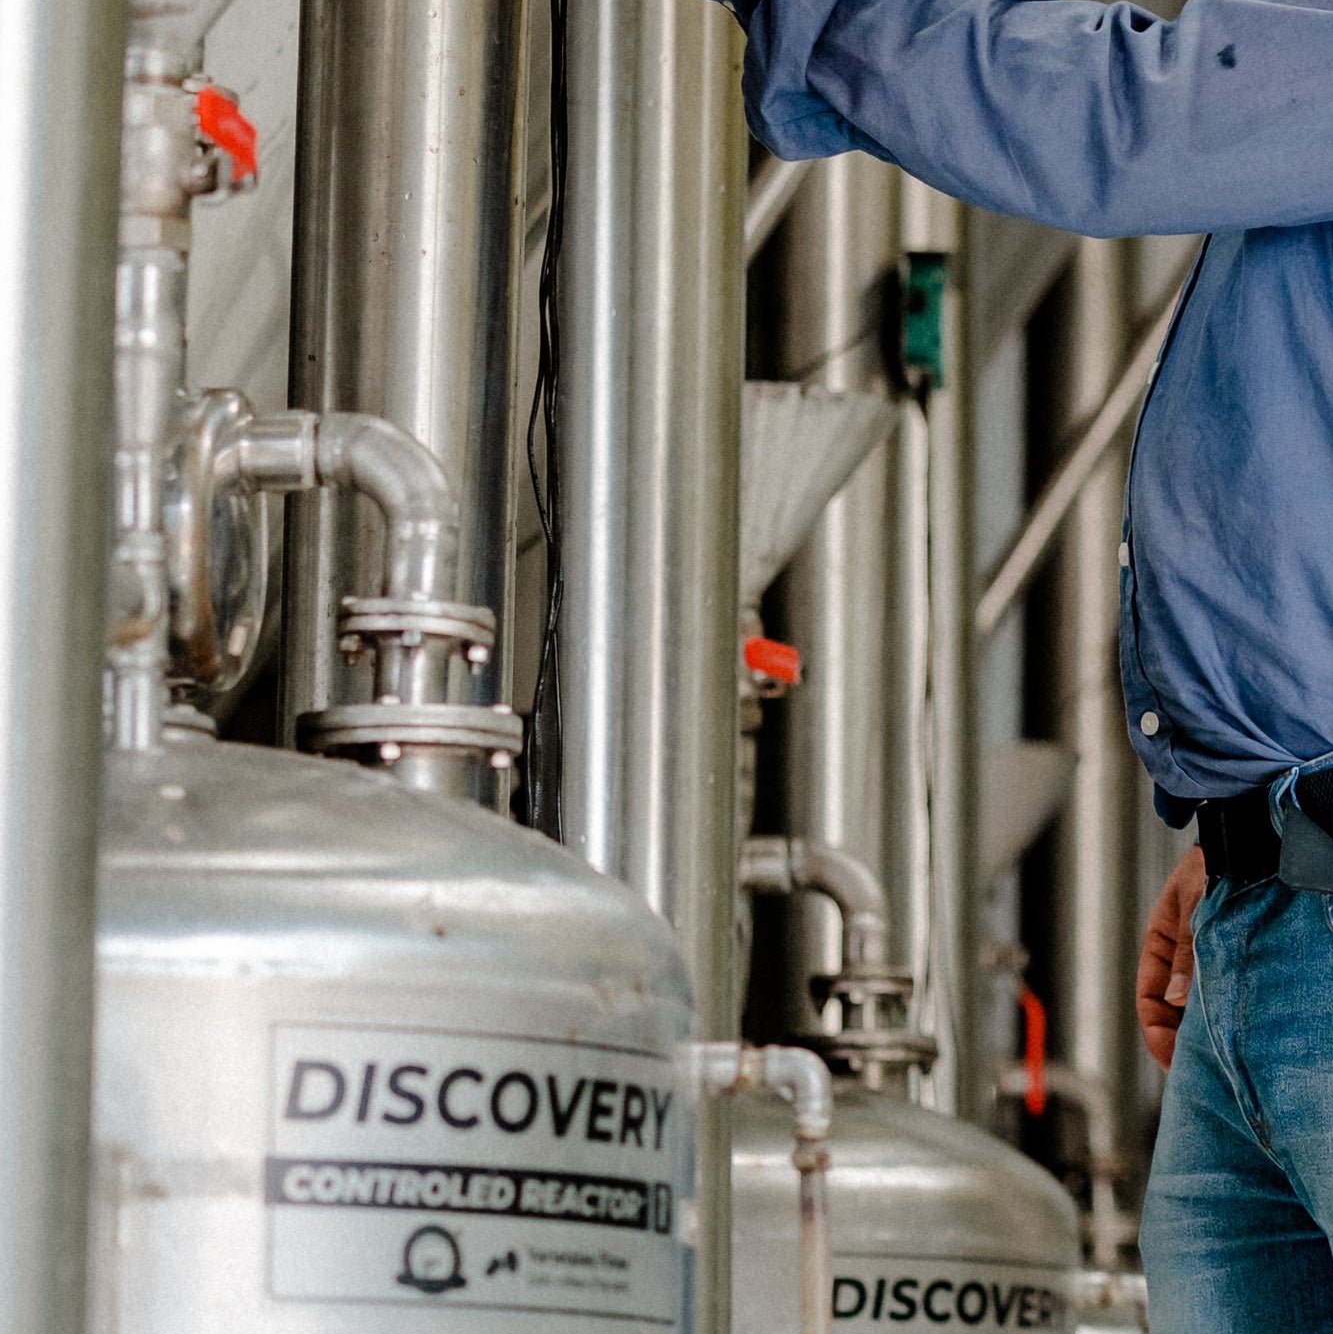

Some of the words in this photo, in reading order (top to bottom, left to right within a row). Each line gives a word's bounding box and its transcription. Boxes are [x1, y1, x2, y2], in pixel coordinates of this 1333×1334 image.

[284, 1060, 674, 1150] DISCOVERY
[282, 1165, 517, 1210] CONTROLED
[519, 1177, 644, 1217] REACTOR
